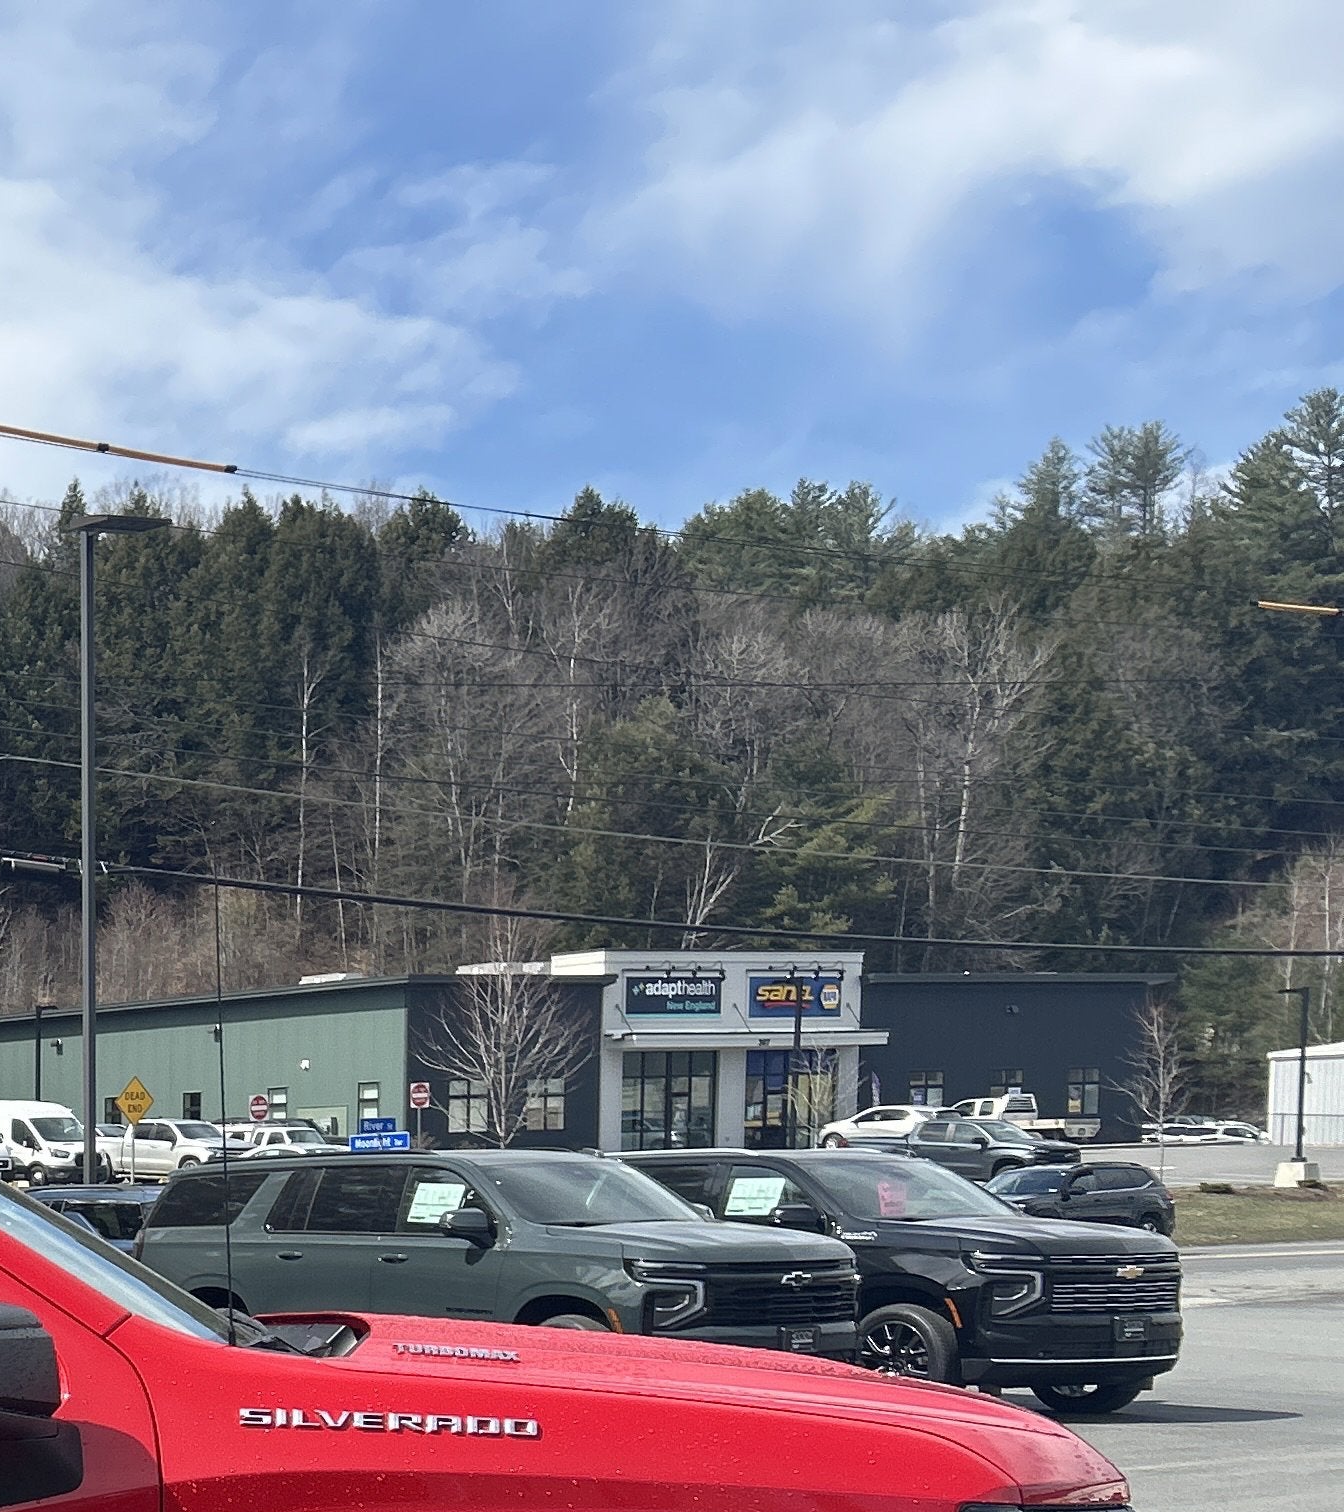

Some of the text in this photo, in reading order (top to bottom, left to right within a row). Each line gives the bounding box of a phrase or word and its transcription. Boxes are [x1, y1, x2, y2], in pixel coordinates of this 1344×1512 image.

[645, 979, 716, 998] adapthealth
[124, 1091, 146, 1101] DEAD
[127, 1103, 143, 1114] END
[363, 1121, 385, 1131] River
[392, 1342, 522, 1363] TURBOMAX
[238, 1407, 538, 1437] SILVERADO
